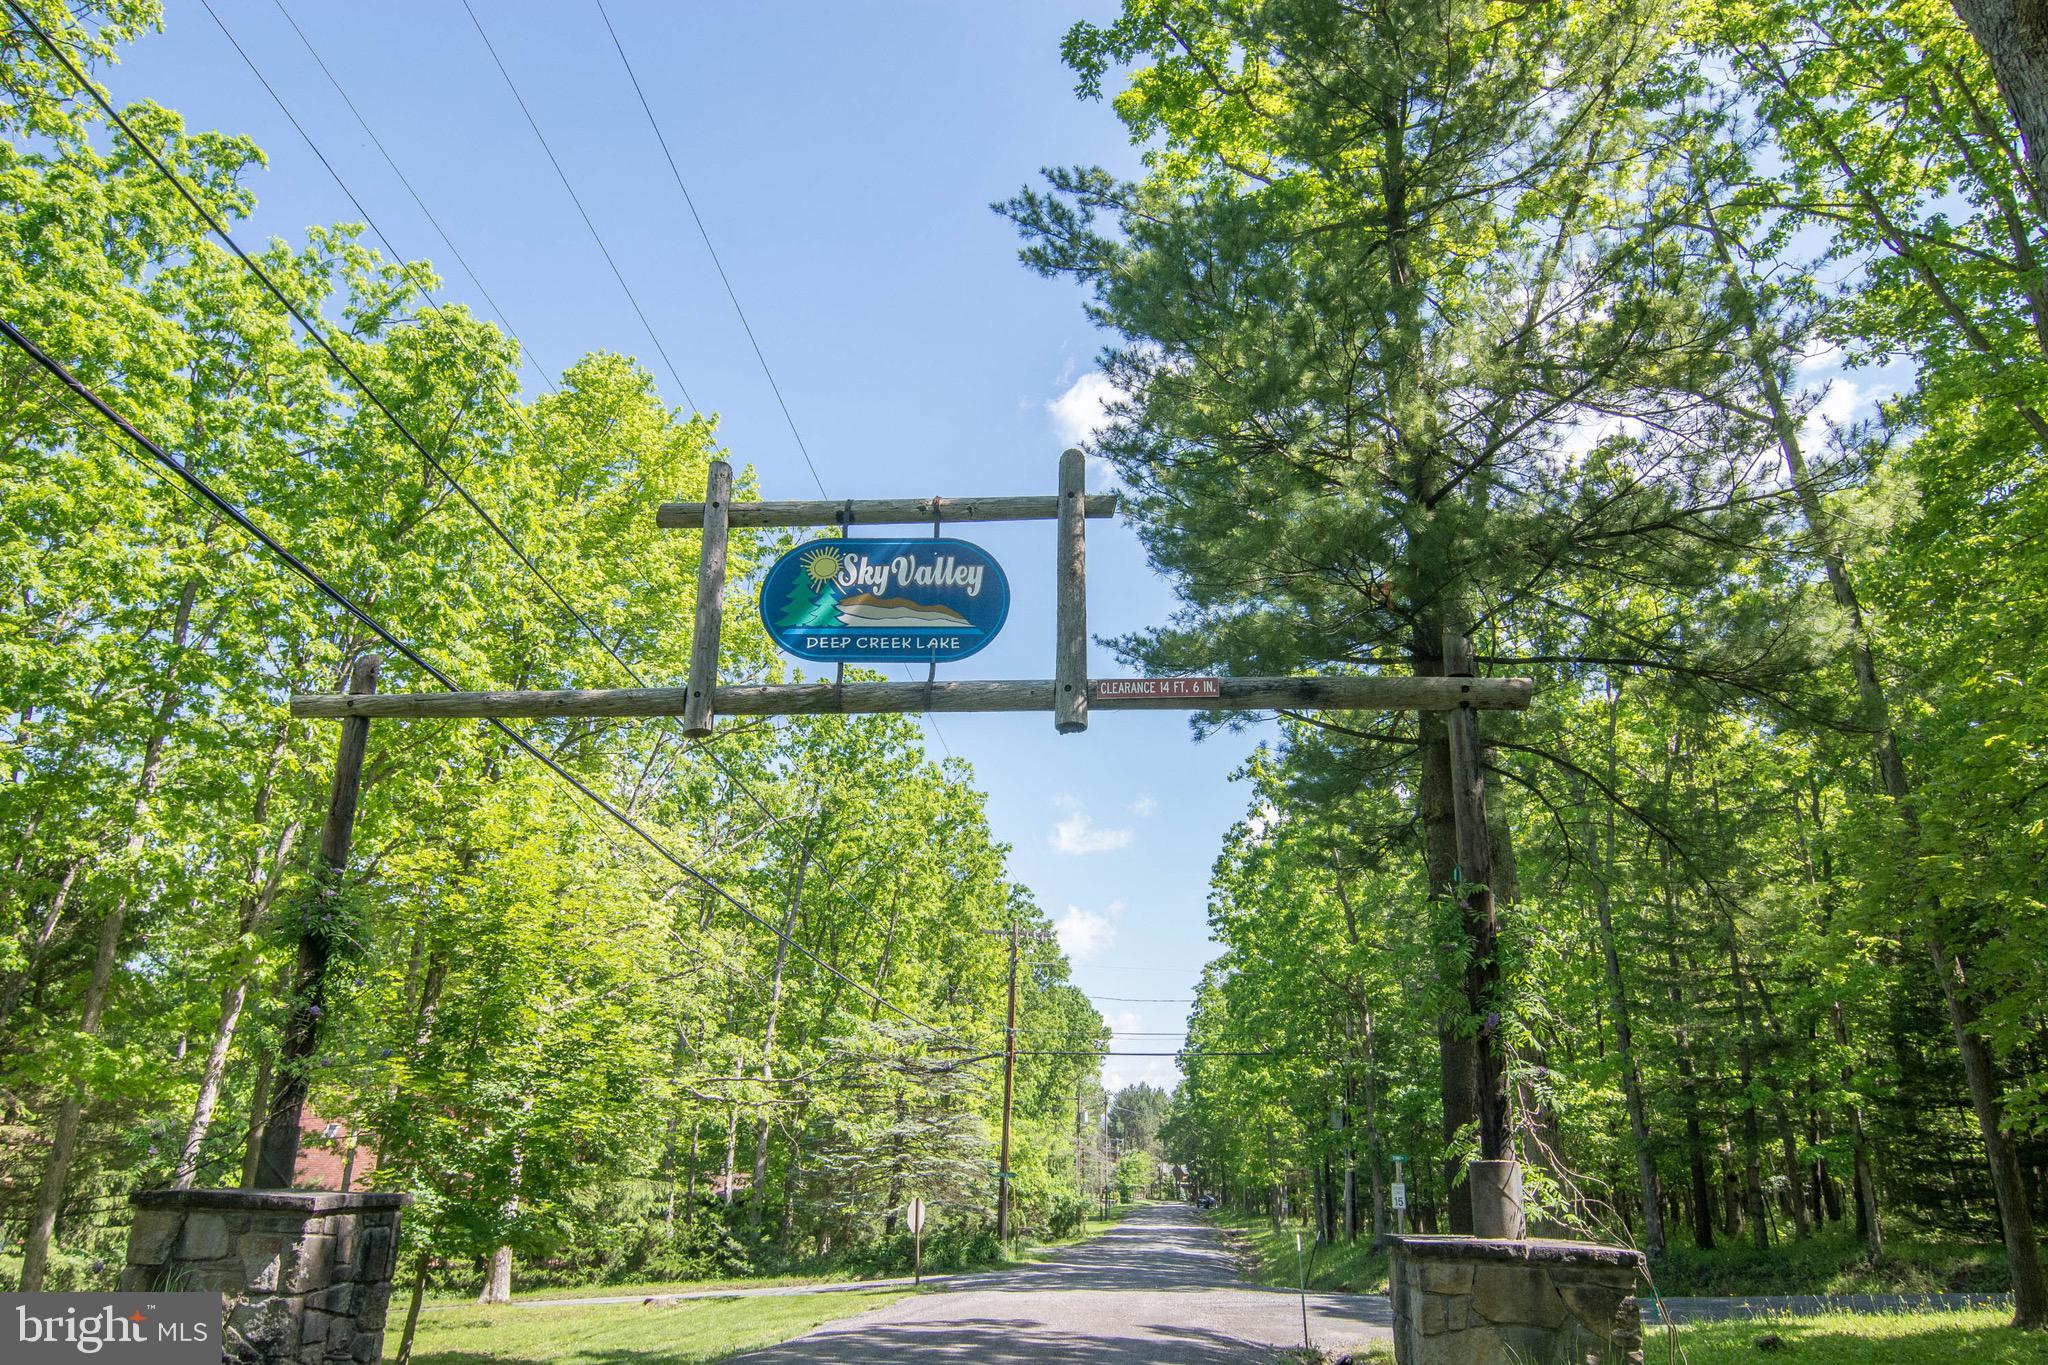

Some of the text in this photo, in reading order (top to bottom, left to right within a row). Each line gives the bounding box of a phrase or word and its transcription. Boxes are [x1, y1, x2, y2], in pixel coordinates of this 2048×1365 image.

[837, 553, 985, 597] Sky Valley
[806, 637, 960, 649] DEEP CREEK LAKE
[1100, 680, 1216, 694] CLEARANCE 14 FT. 6 IN.
[1394, 1196, 1404, 1207] 15
